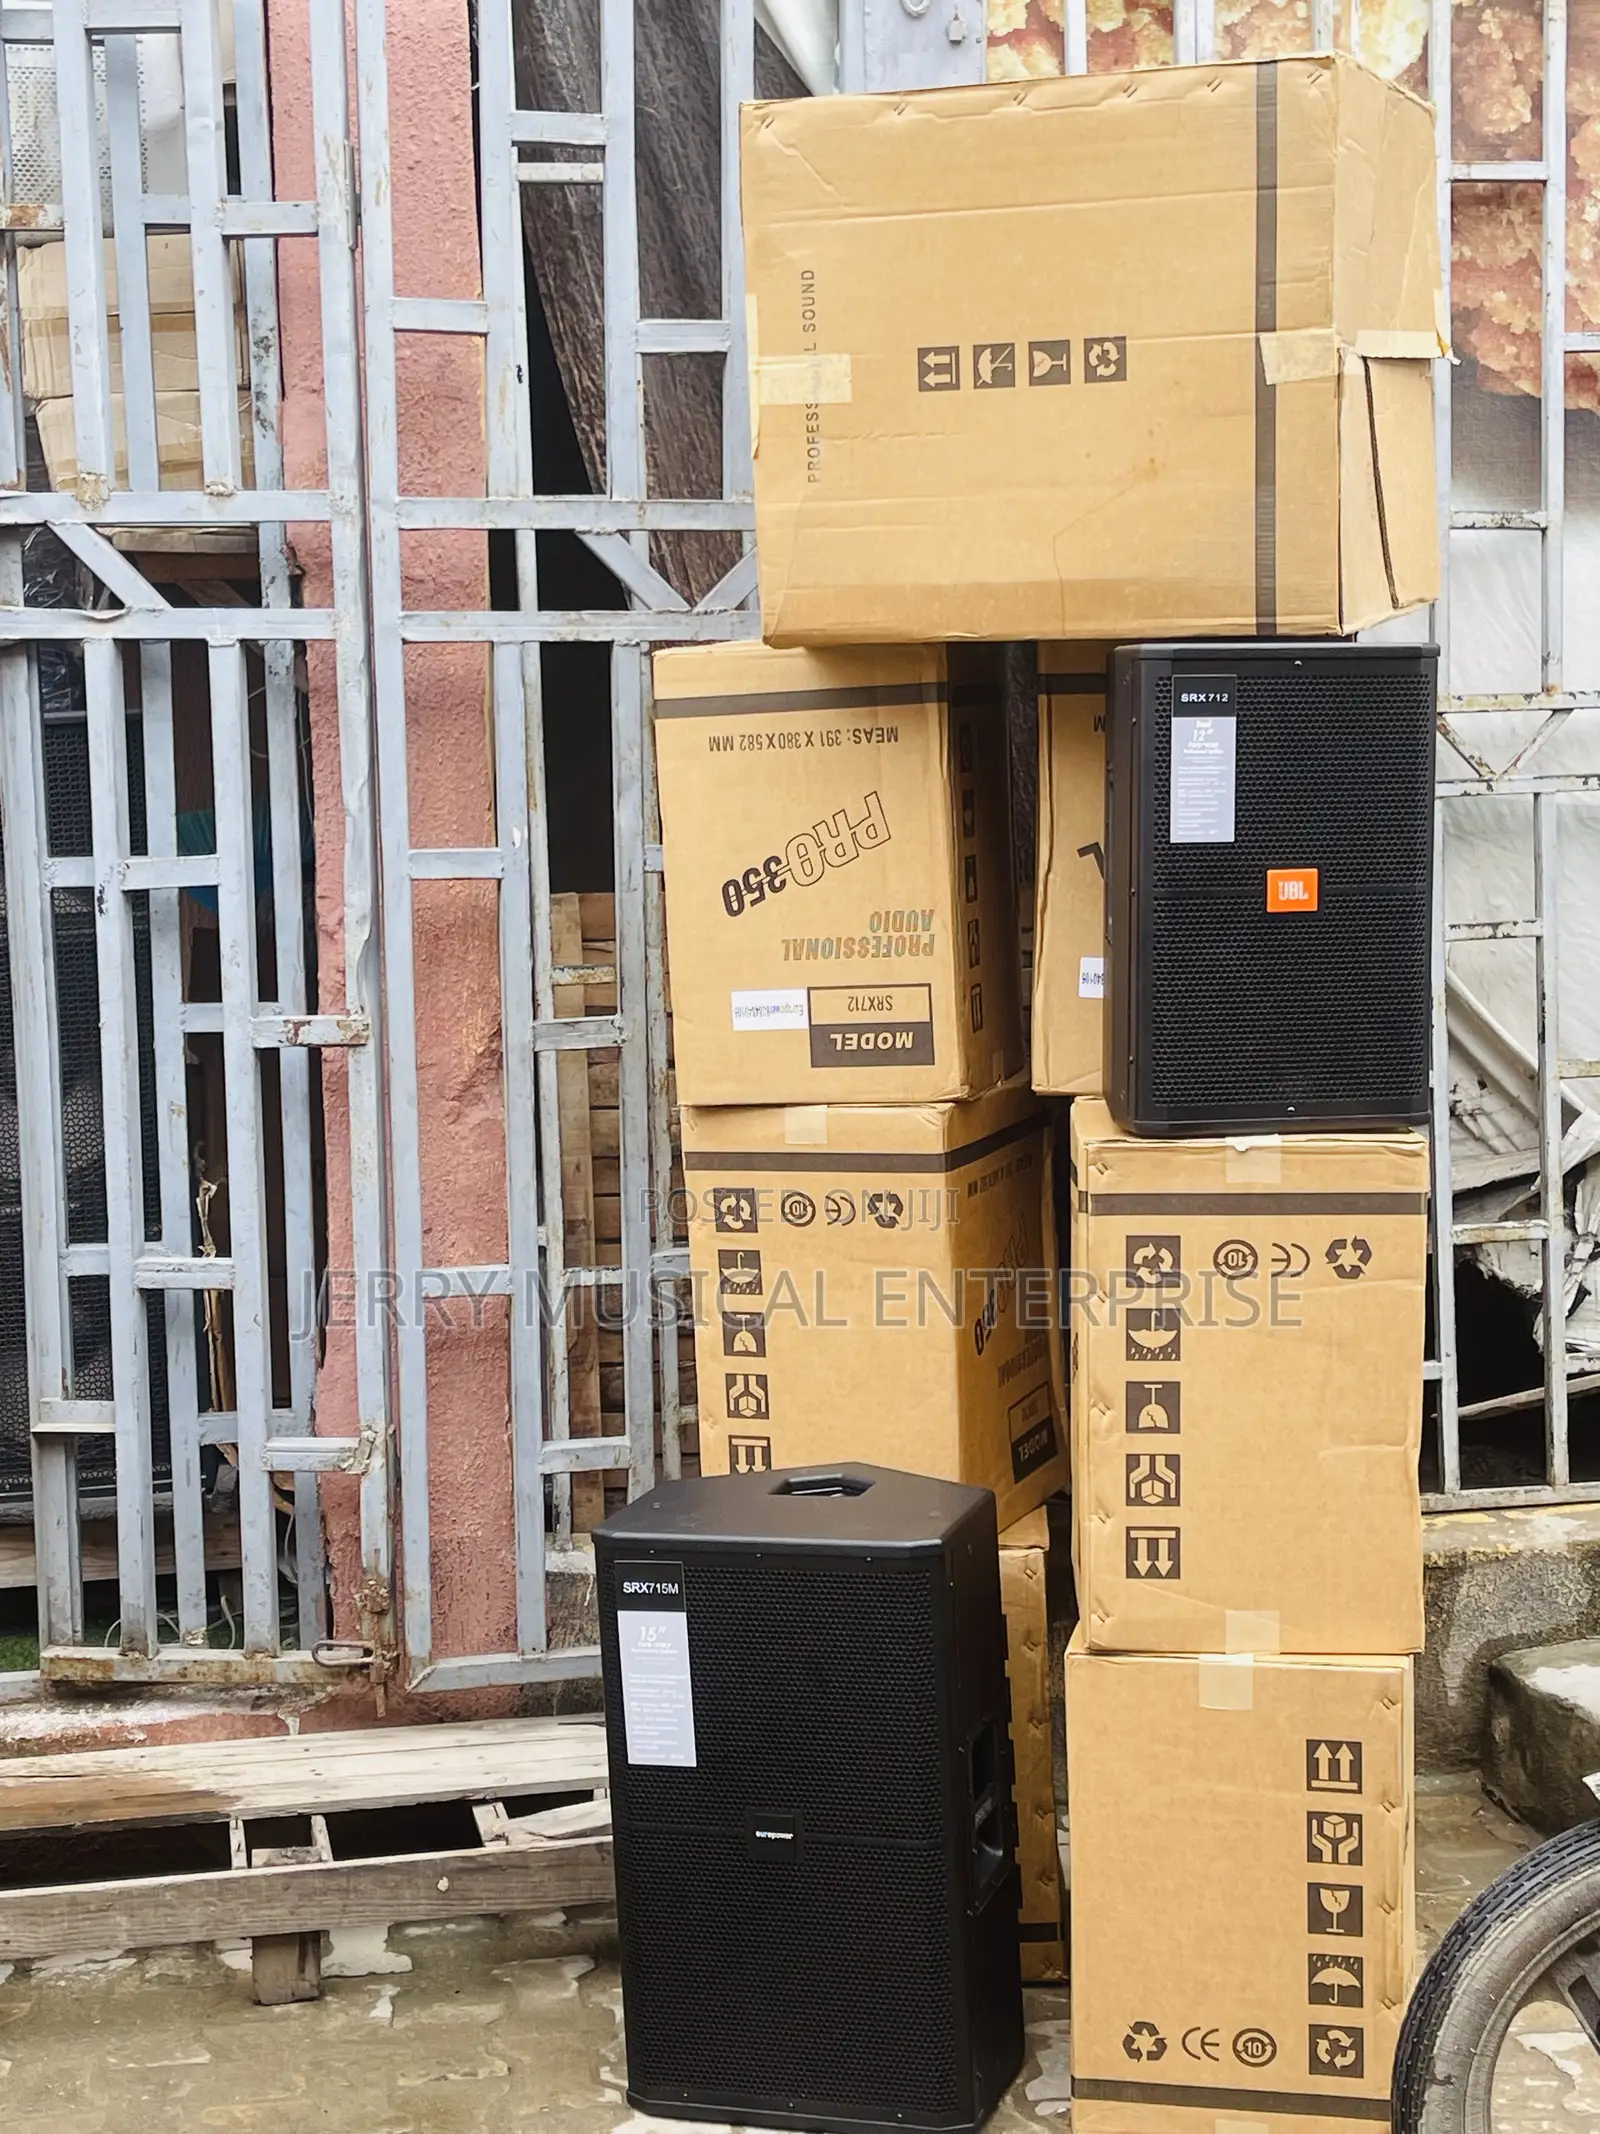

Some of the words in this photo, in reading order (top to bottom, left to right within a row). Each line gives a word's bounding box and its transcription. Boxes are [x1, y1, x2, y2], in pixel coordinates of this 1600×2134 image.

[800, 269, 817, 333] SOUND
[803, 342, 821, 484] PROFESSL
[708, 735, 734, 753] MM
[819, 728, 842, 748] 391
[846, 726, 899, 745] MEAS:
[1277, 880, 1309, 901] JBL
[868, 908, 935, 933] AUDIO
[780, 935, 936, 962] PROFESSIONAL
[847, 994, 894, 1013] SRX712
[829, 1031, 914, 1051] MODEL
[622, 1581, 679, 1595] SRX715M
